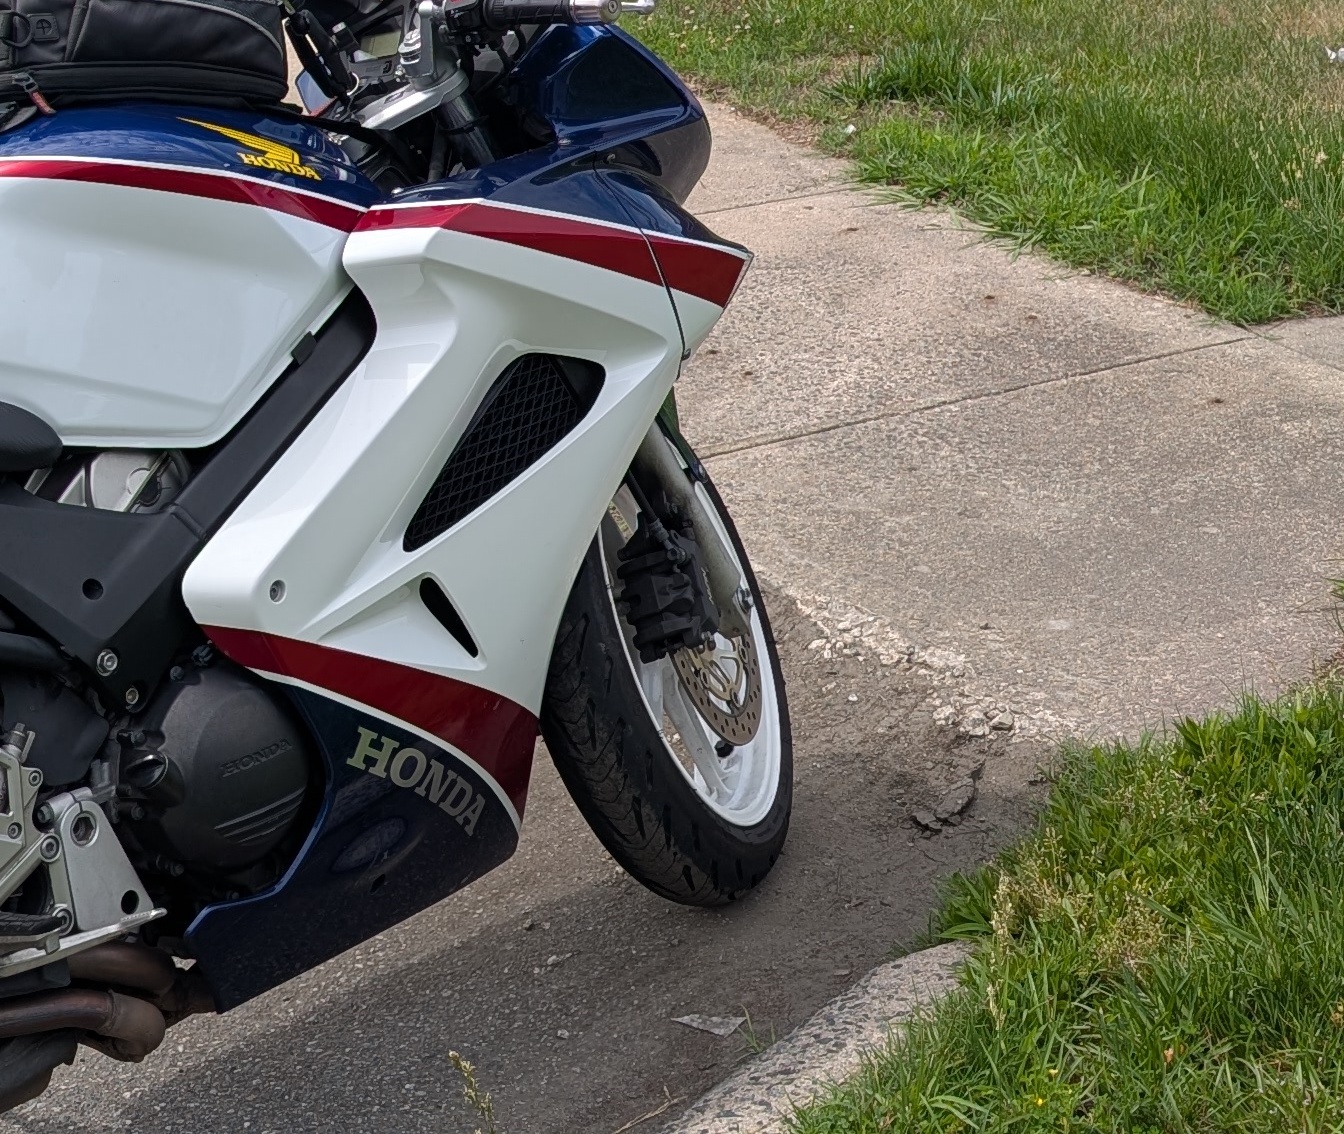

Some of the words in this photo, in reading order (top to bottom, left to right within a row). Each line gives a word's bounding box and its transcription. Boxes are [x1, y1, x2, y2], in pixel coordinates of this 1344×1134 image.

[237, 152, 322, 181] HONDA
[220, 738, 293, 778] HONDA
[346, 725, 486, 837] HONDA
